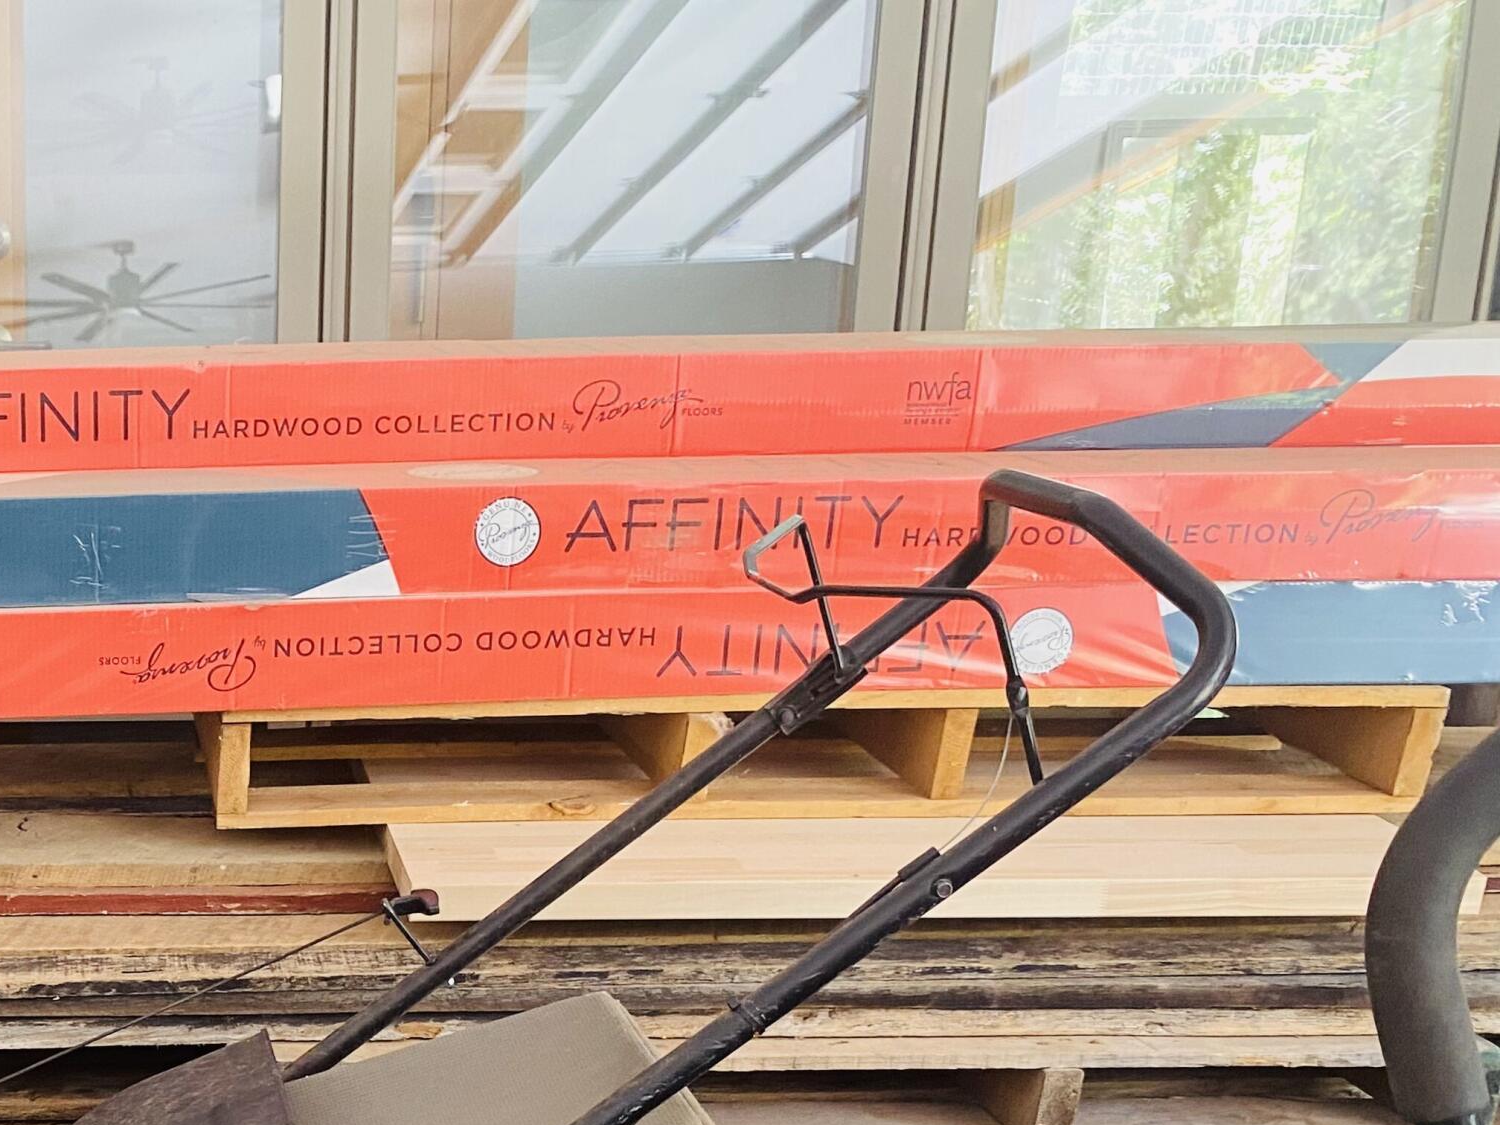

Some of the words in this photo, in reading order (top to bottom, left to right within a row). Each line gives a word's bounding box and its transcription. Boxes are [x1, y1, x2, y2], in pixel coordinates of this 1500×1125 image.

[907, 371, 971, 406] nwfa
[681, 407, 723, 417] FLOORS
[192, 415, 363, 439] HARDWOOD
[375, 412, 556, 435] COLLECTION
[564, 494, 904, 552] AFFINITY
[902, 525, 1088, 547] HAROOD
[1163, 523, 1300, 545] LECTION
[274, 632, 462, 658] COLLECTION
[477, 626, 656, 650] HARDWOOD
[657, 620, 986, 677] AFNITY
[98, 656, 141, 666] FLOORS
